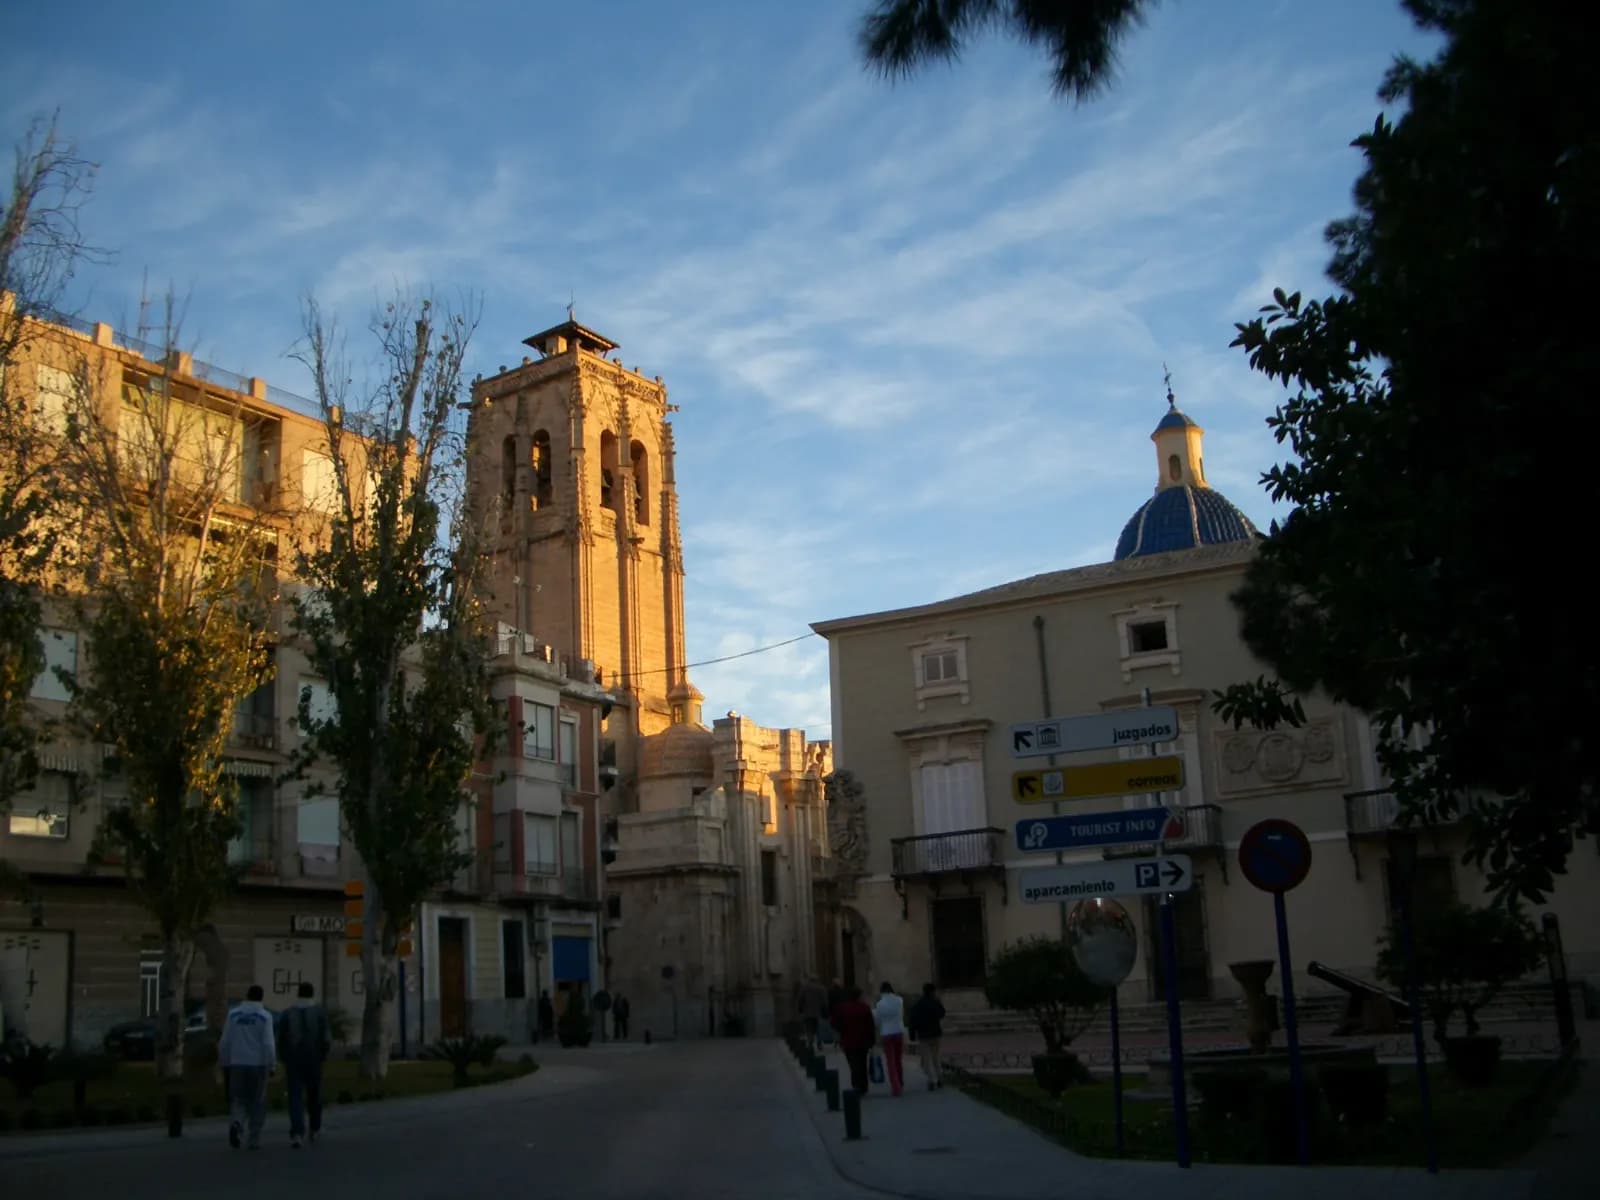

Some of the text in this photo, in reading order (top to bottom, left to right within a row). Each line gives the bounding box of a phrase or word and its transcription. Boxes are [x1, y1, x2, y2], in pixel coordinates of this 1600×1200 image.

[1113, 724, 1171, 743] juzgados
[1127, 774, 1177, 789] correos
[1069, 819, 1156, 837] TOURIST INFO
[1025, 866, 1155, 900] aparcamiento P
